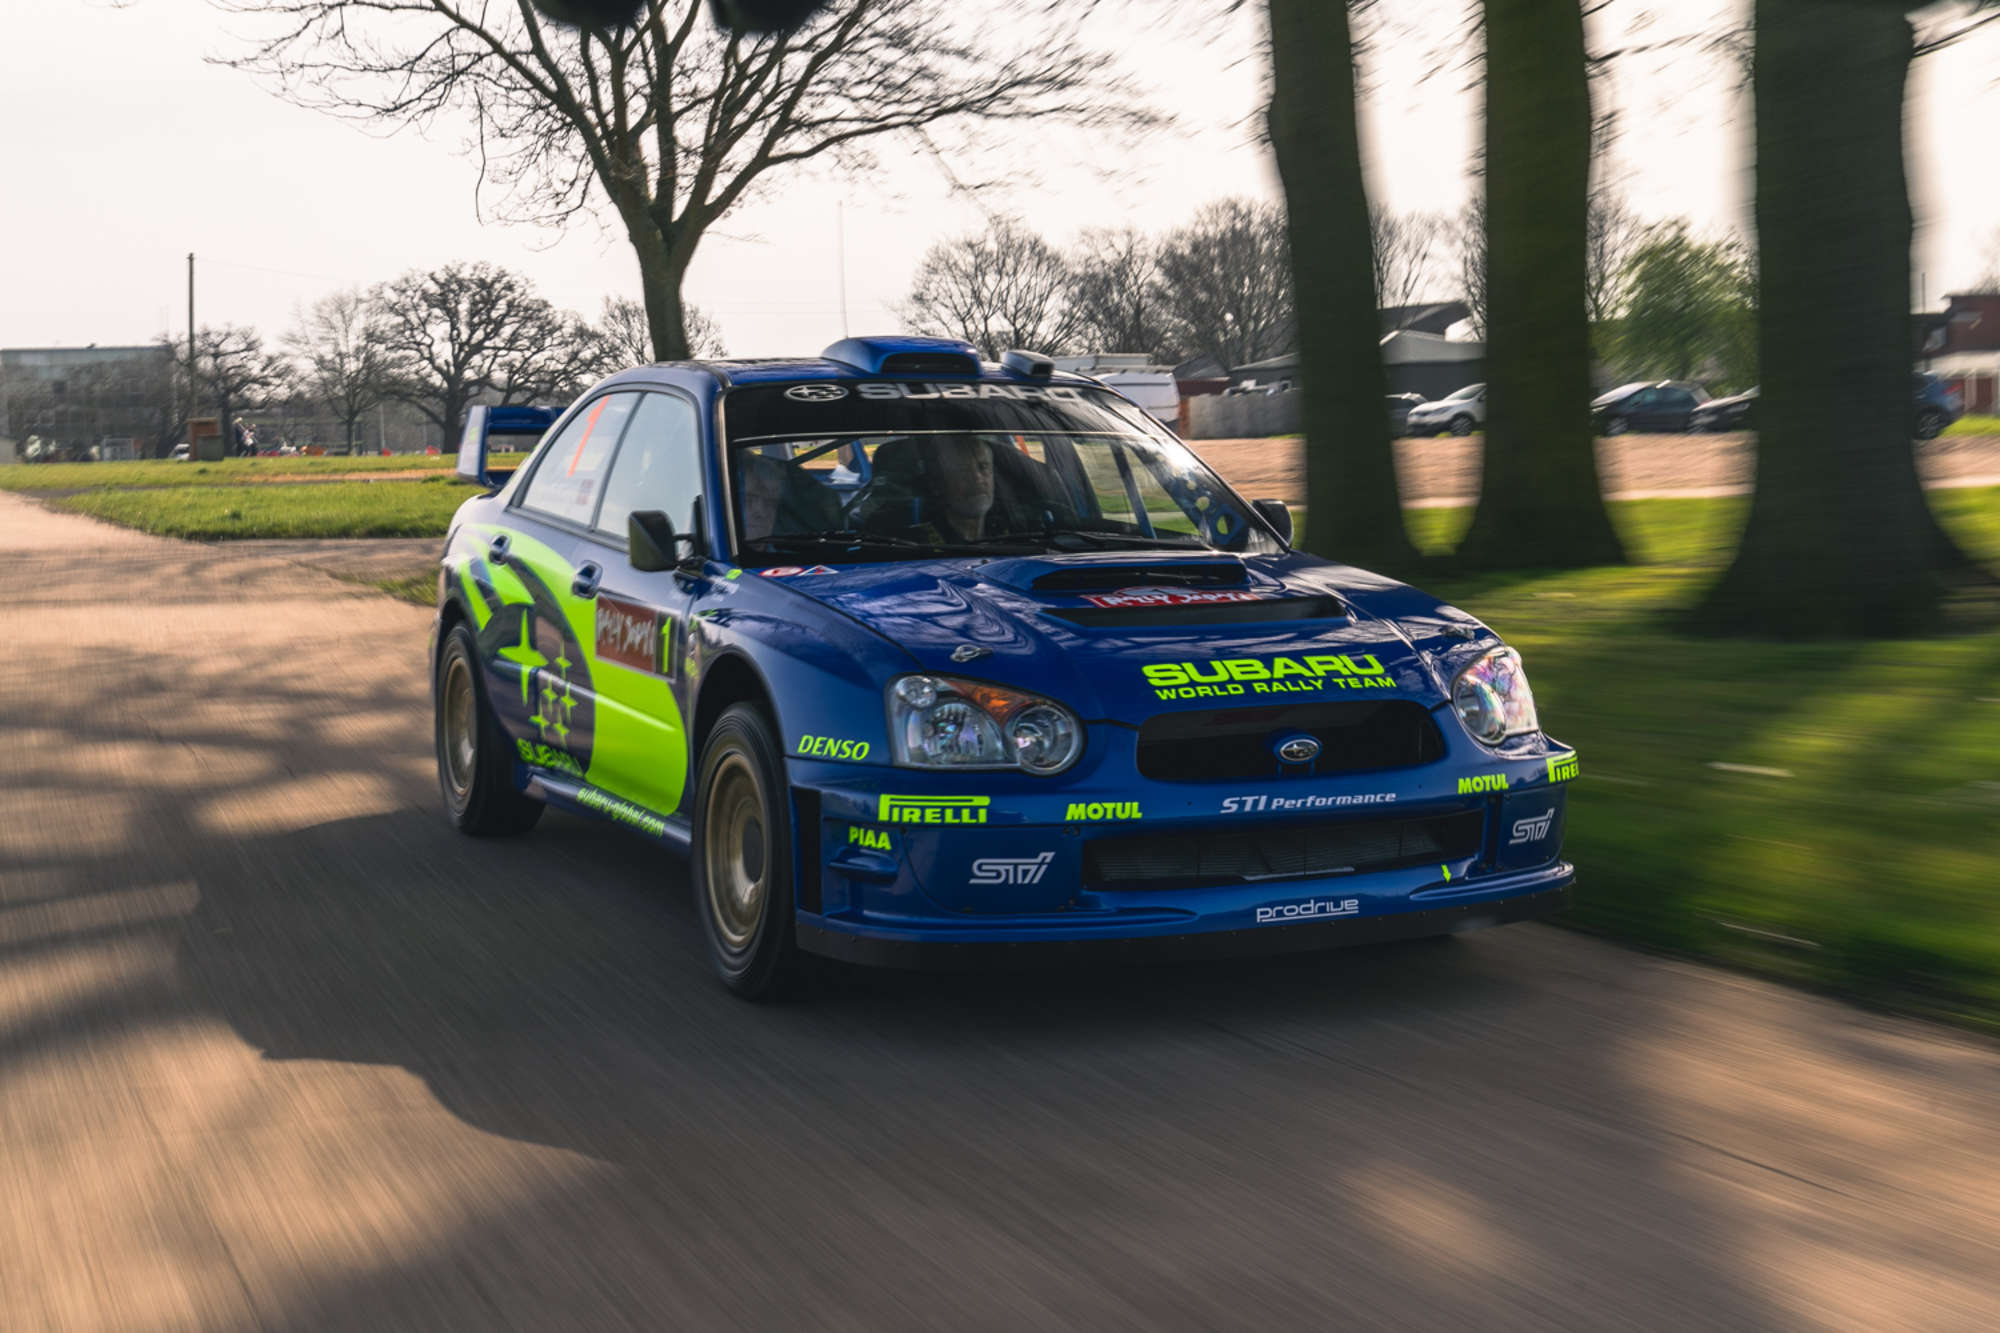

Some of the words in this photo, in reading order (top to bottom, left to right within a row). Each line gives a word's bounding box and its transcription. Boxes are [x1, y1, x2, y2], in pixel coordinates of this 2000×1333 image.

[856, 383, 1083, 402] SUBARU
[661, 615, 672, 673] 1
[1141, 654, 1385, 686] SUBARU
[1155, 683, 1245, 700] WORLD
[1252, 678, 1324, 694] RALLY
[1332, 676, 1397, 689] TEAM
[797, 734, 870, 760] DENSO
[1457, 773, 1509, 795] MOTUL
[878, 794, 991, 823] PIRELLI
[1065, 802, 1142, 820] MOTUL
[1219, 795, 1268, 814] STI
[1270, 792, 1397, 811] Performance
[849, 826, 892, 850] PIAA
[1256, 899, 1360, 923] prodrive
